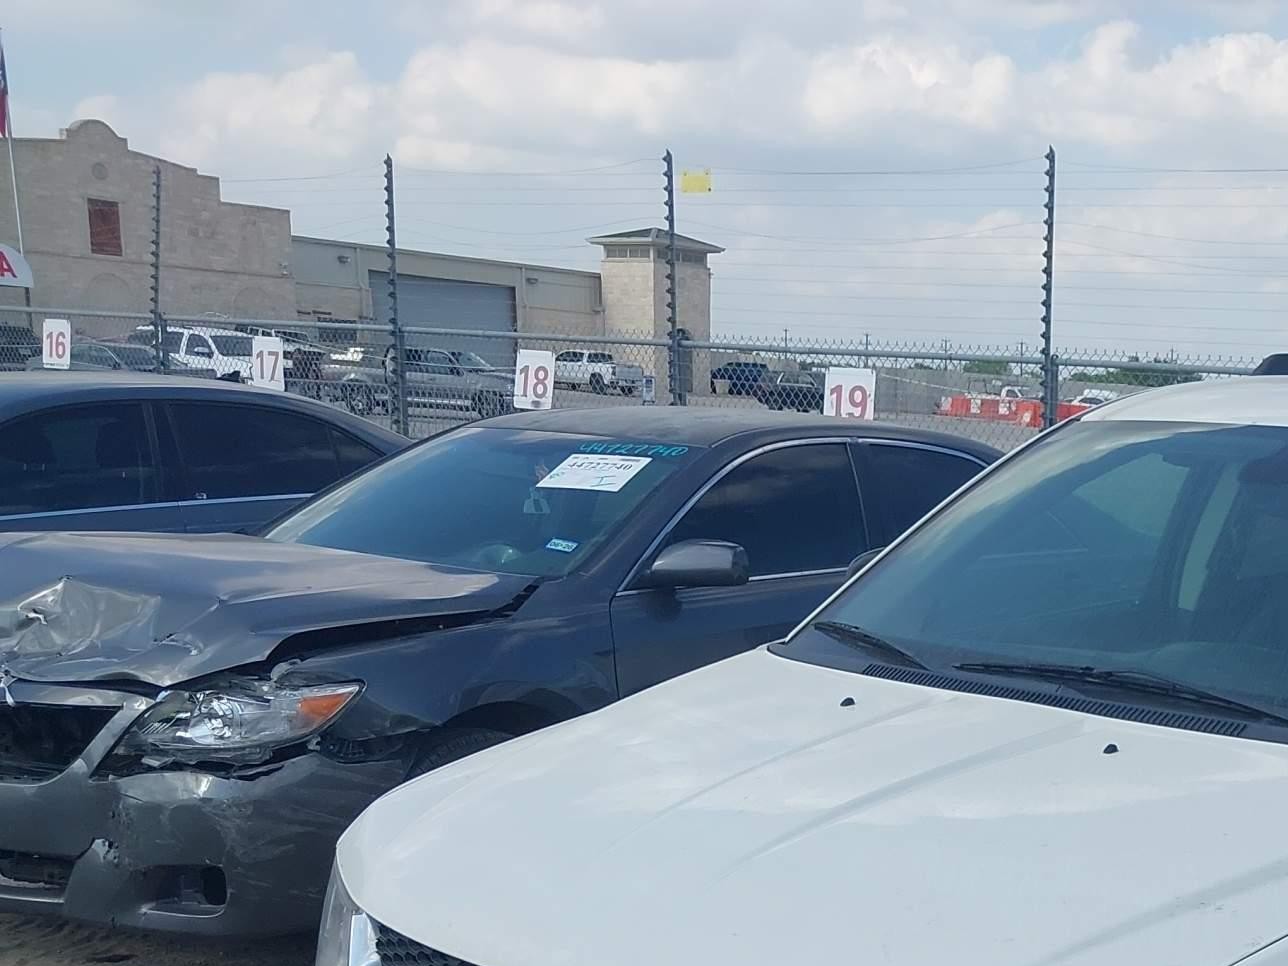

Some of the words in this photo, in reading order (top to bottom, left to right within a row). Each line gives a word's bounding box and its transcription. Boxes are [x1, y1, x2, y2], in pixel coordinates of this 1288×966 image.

[46, 330, 66, 360] 16
[256, 350, 280, 383] 17
[519, 364, 550, 397] 18
[829, 384, 870, 420] 19
[579, 442, 689, 458] 44727740
[567, 461, 633, 472] 44727740
